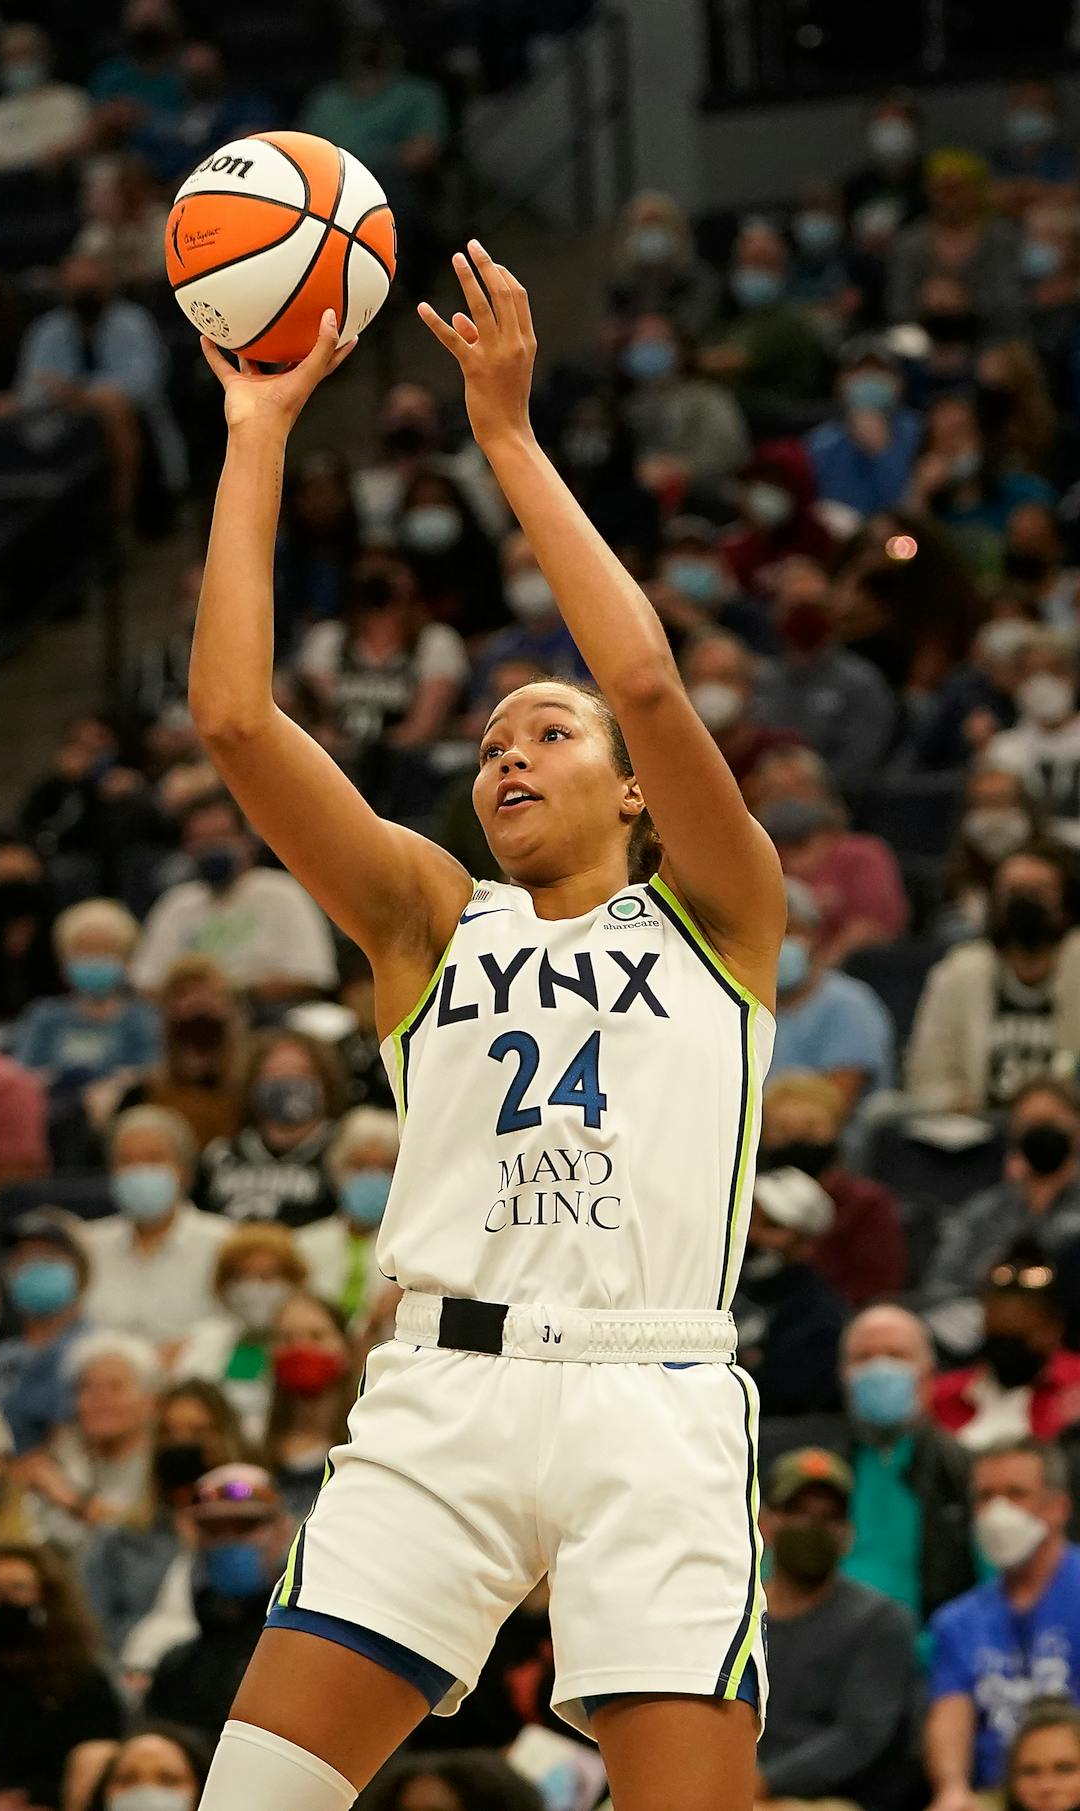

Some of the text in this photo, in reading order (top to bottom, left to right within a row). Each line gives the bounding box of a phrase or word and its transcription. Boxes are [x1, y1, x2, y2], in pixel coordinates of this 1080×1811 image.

[603, 919, 660, 930] sharecare
[437, 947, 670, 1028] LYNX
[487, 1030, 607, 1136] 24
[497, 1148, 613, 1194] MAYO
[484, 1190, 621, 1233] CLINC
